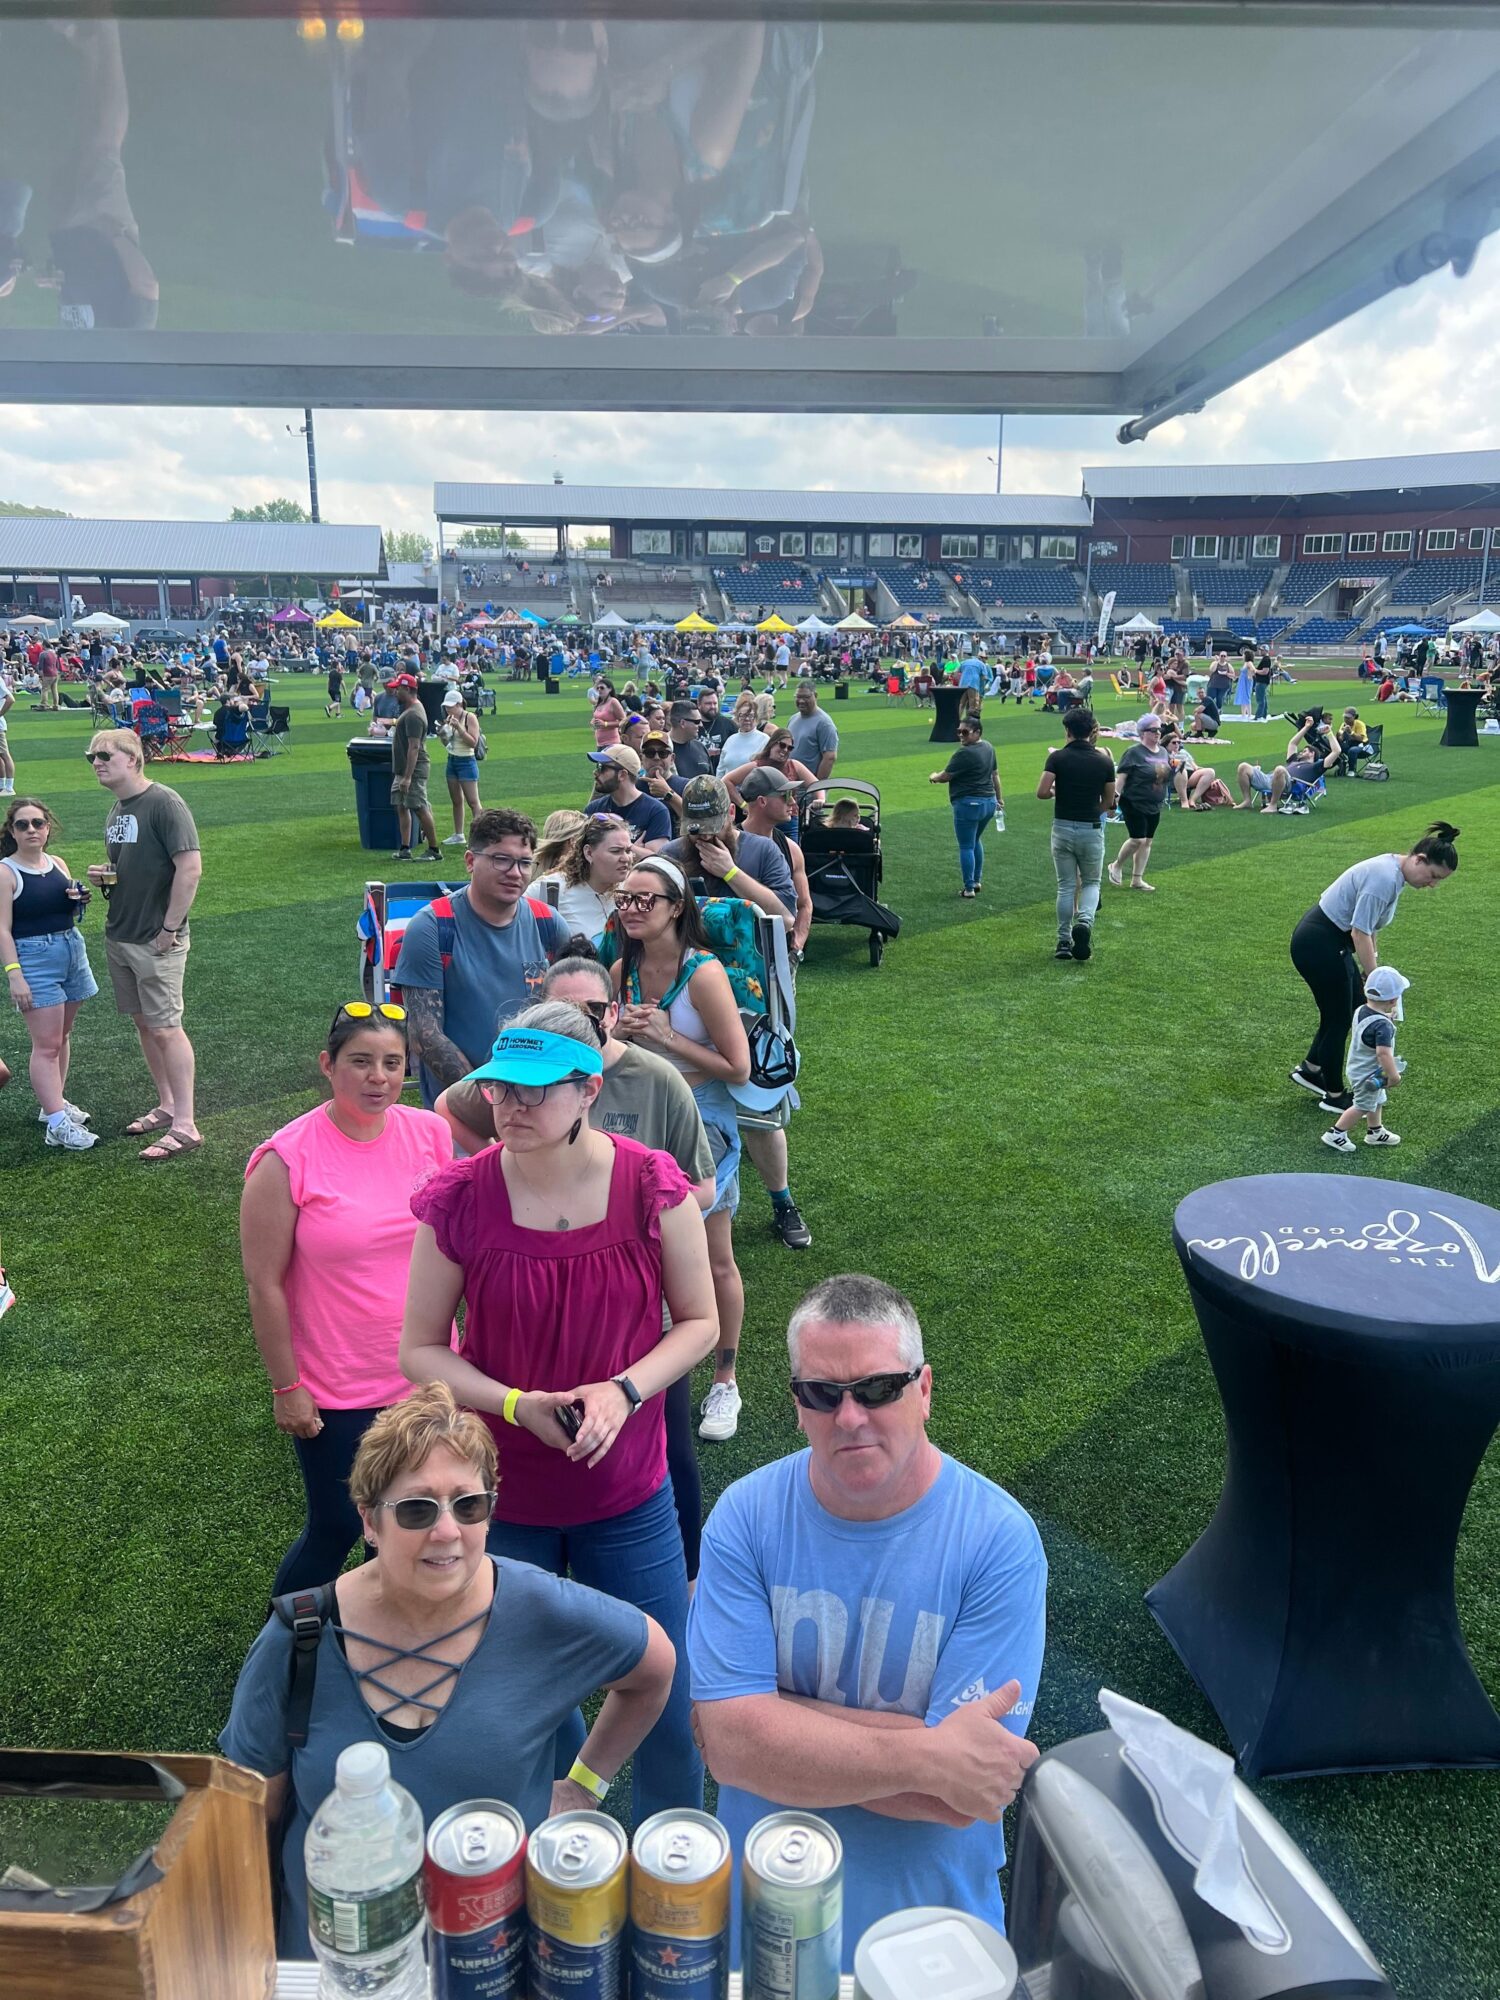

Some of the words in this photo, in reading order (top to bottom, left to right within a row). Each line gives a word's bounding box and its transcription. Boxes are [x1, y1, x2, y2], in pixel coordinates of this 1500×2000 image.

[116, 815, 130, 824] THE
[510, 1038, 544, 1046] HOWMET
[1278, 1227, 1345, 1235] GOD
[1387, 1256, 1454, 1268] The
